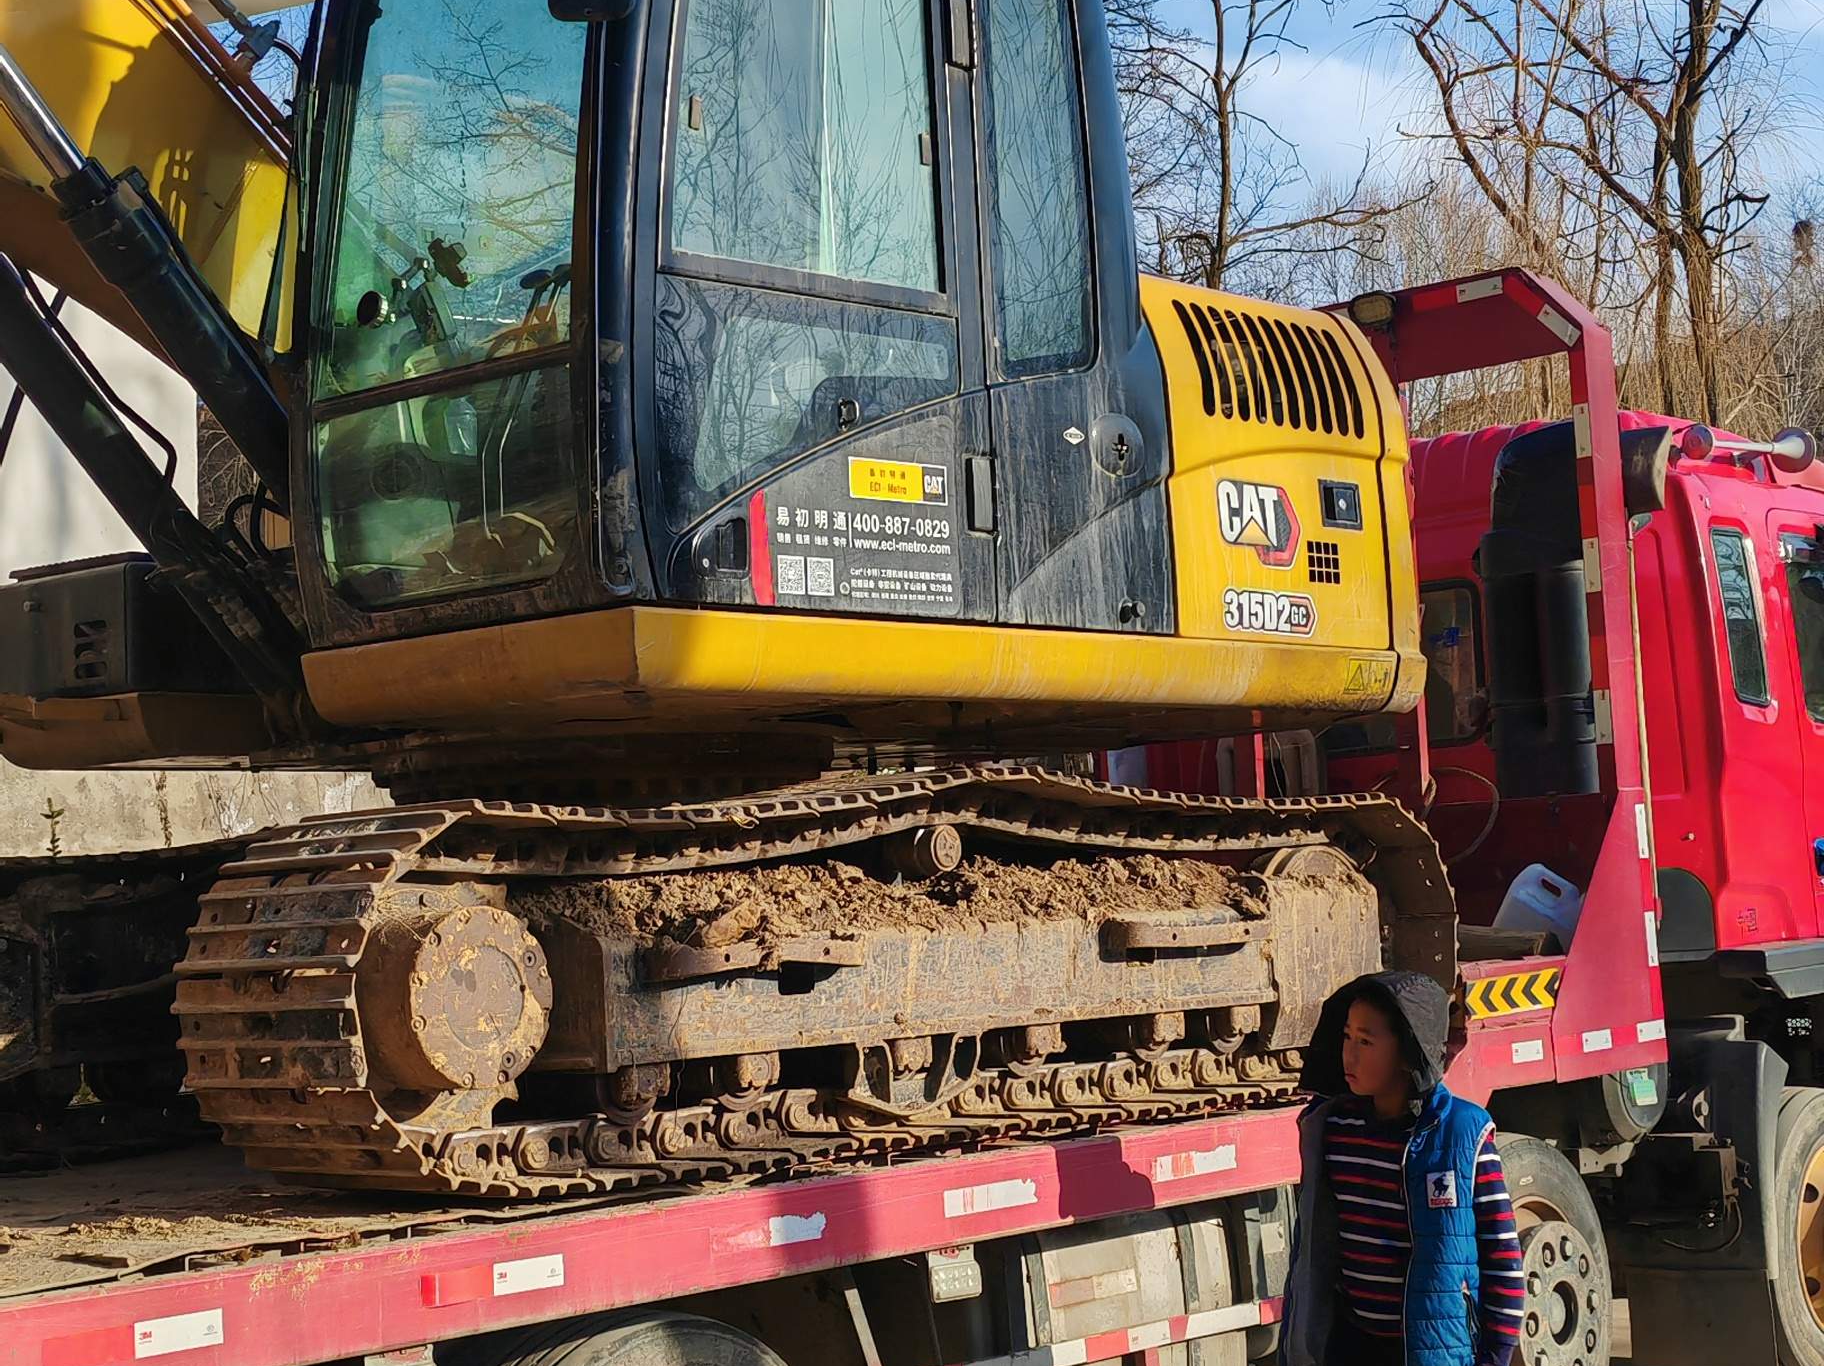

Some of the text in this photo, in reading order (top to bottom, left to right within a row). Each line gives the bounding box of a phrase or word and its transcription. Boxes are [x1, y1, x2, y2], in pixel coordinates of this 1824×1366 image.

[924, 475, 943, 494] CAT
[776, 506, 847, 531] 易初明通
[1217, 480, 1278, 547] CAT
[853, 514, 950, 539] 400-887-0829
